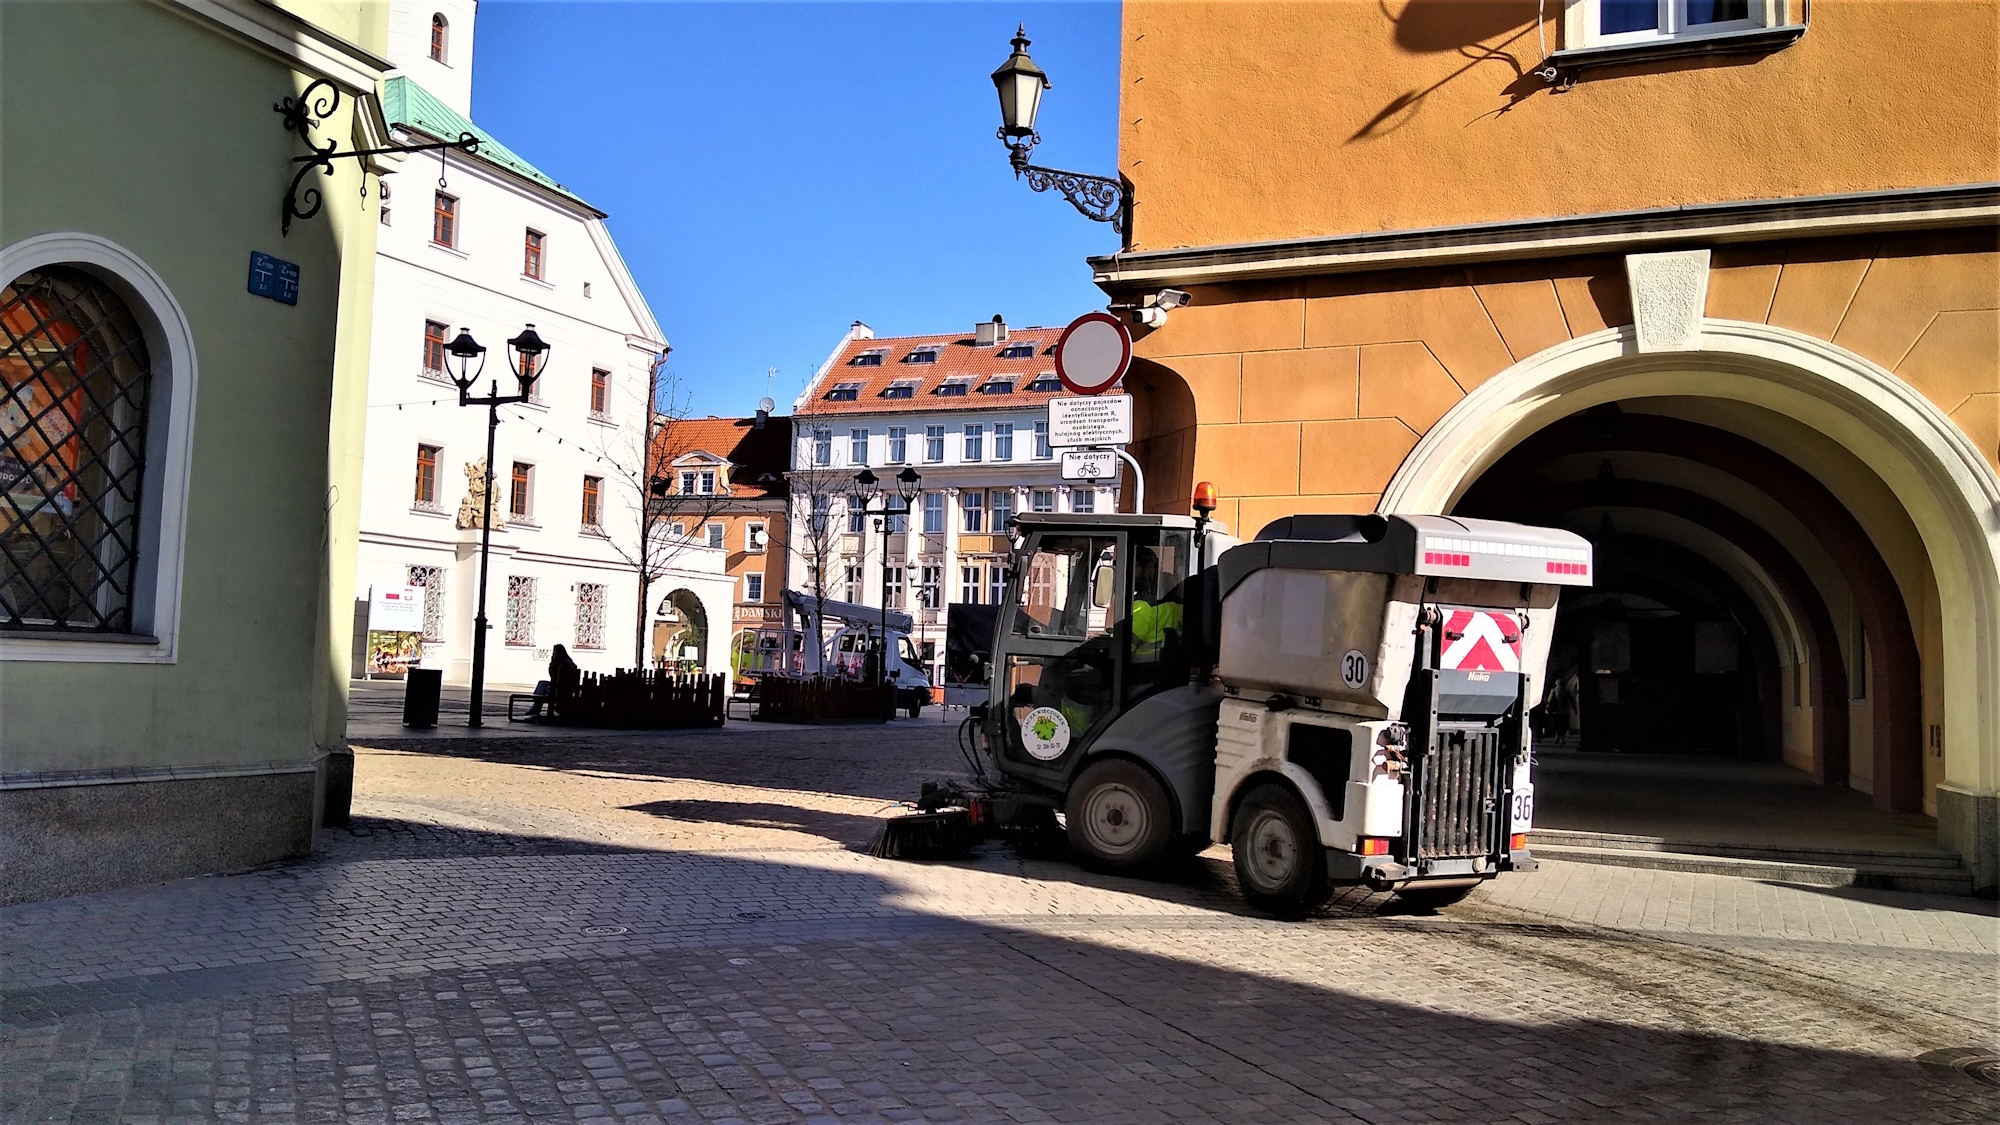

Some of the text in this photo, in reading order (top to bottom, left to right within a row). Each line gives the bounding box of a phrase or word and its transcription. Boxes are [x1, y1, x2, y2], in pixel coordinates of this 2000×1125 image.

[1084, 453, 1110, 461] dotyczy
[1345, 655, 1364, 684] 30
[1466, 670, 1491, 682] Hako
[1024, 709, 1065, 729] JACEK WIECZOREK
[1513, 794, 1532, 821] 36
